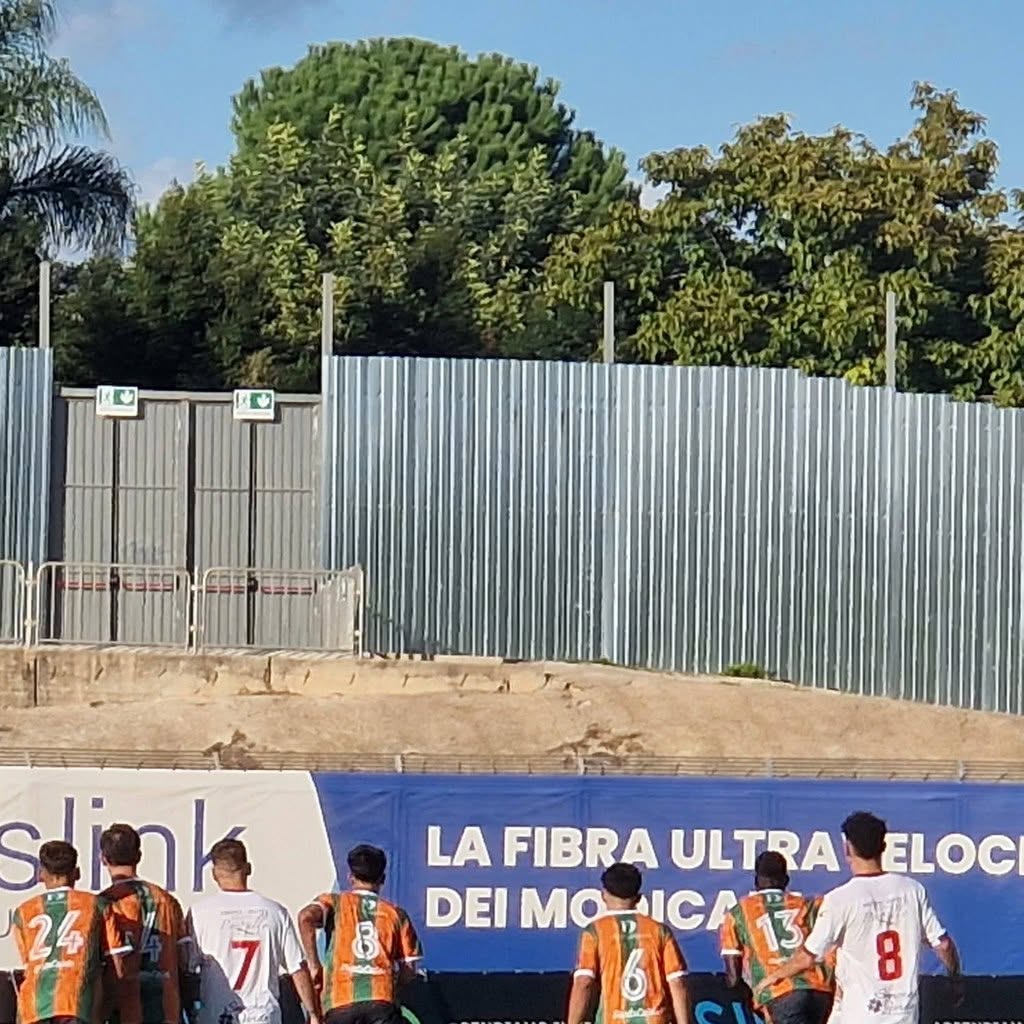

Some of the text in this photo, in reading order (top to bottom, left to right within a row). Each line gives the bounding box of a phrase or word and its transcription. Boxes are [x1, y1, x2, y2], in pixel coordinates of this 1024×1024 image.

[427, 825, 1024, 876] LA FIBRA ULTRA ELOC
[426, 887, 508, 928] DEI
[520, 888, 802, 930] MOICA
[756, 908, 803, 951] 13
[28, 910, 85, 961] 24
[876, 930, 902, 981] 8
[231, 940, 260, 990] 7
[621, 948, 647, 1001] 6
